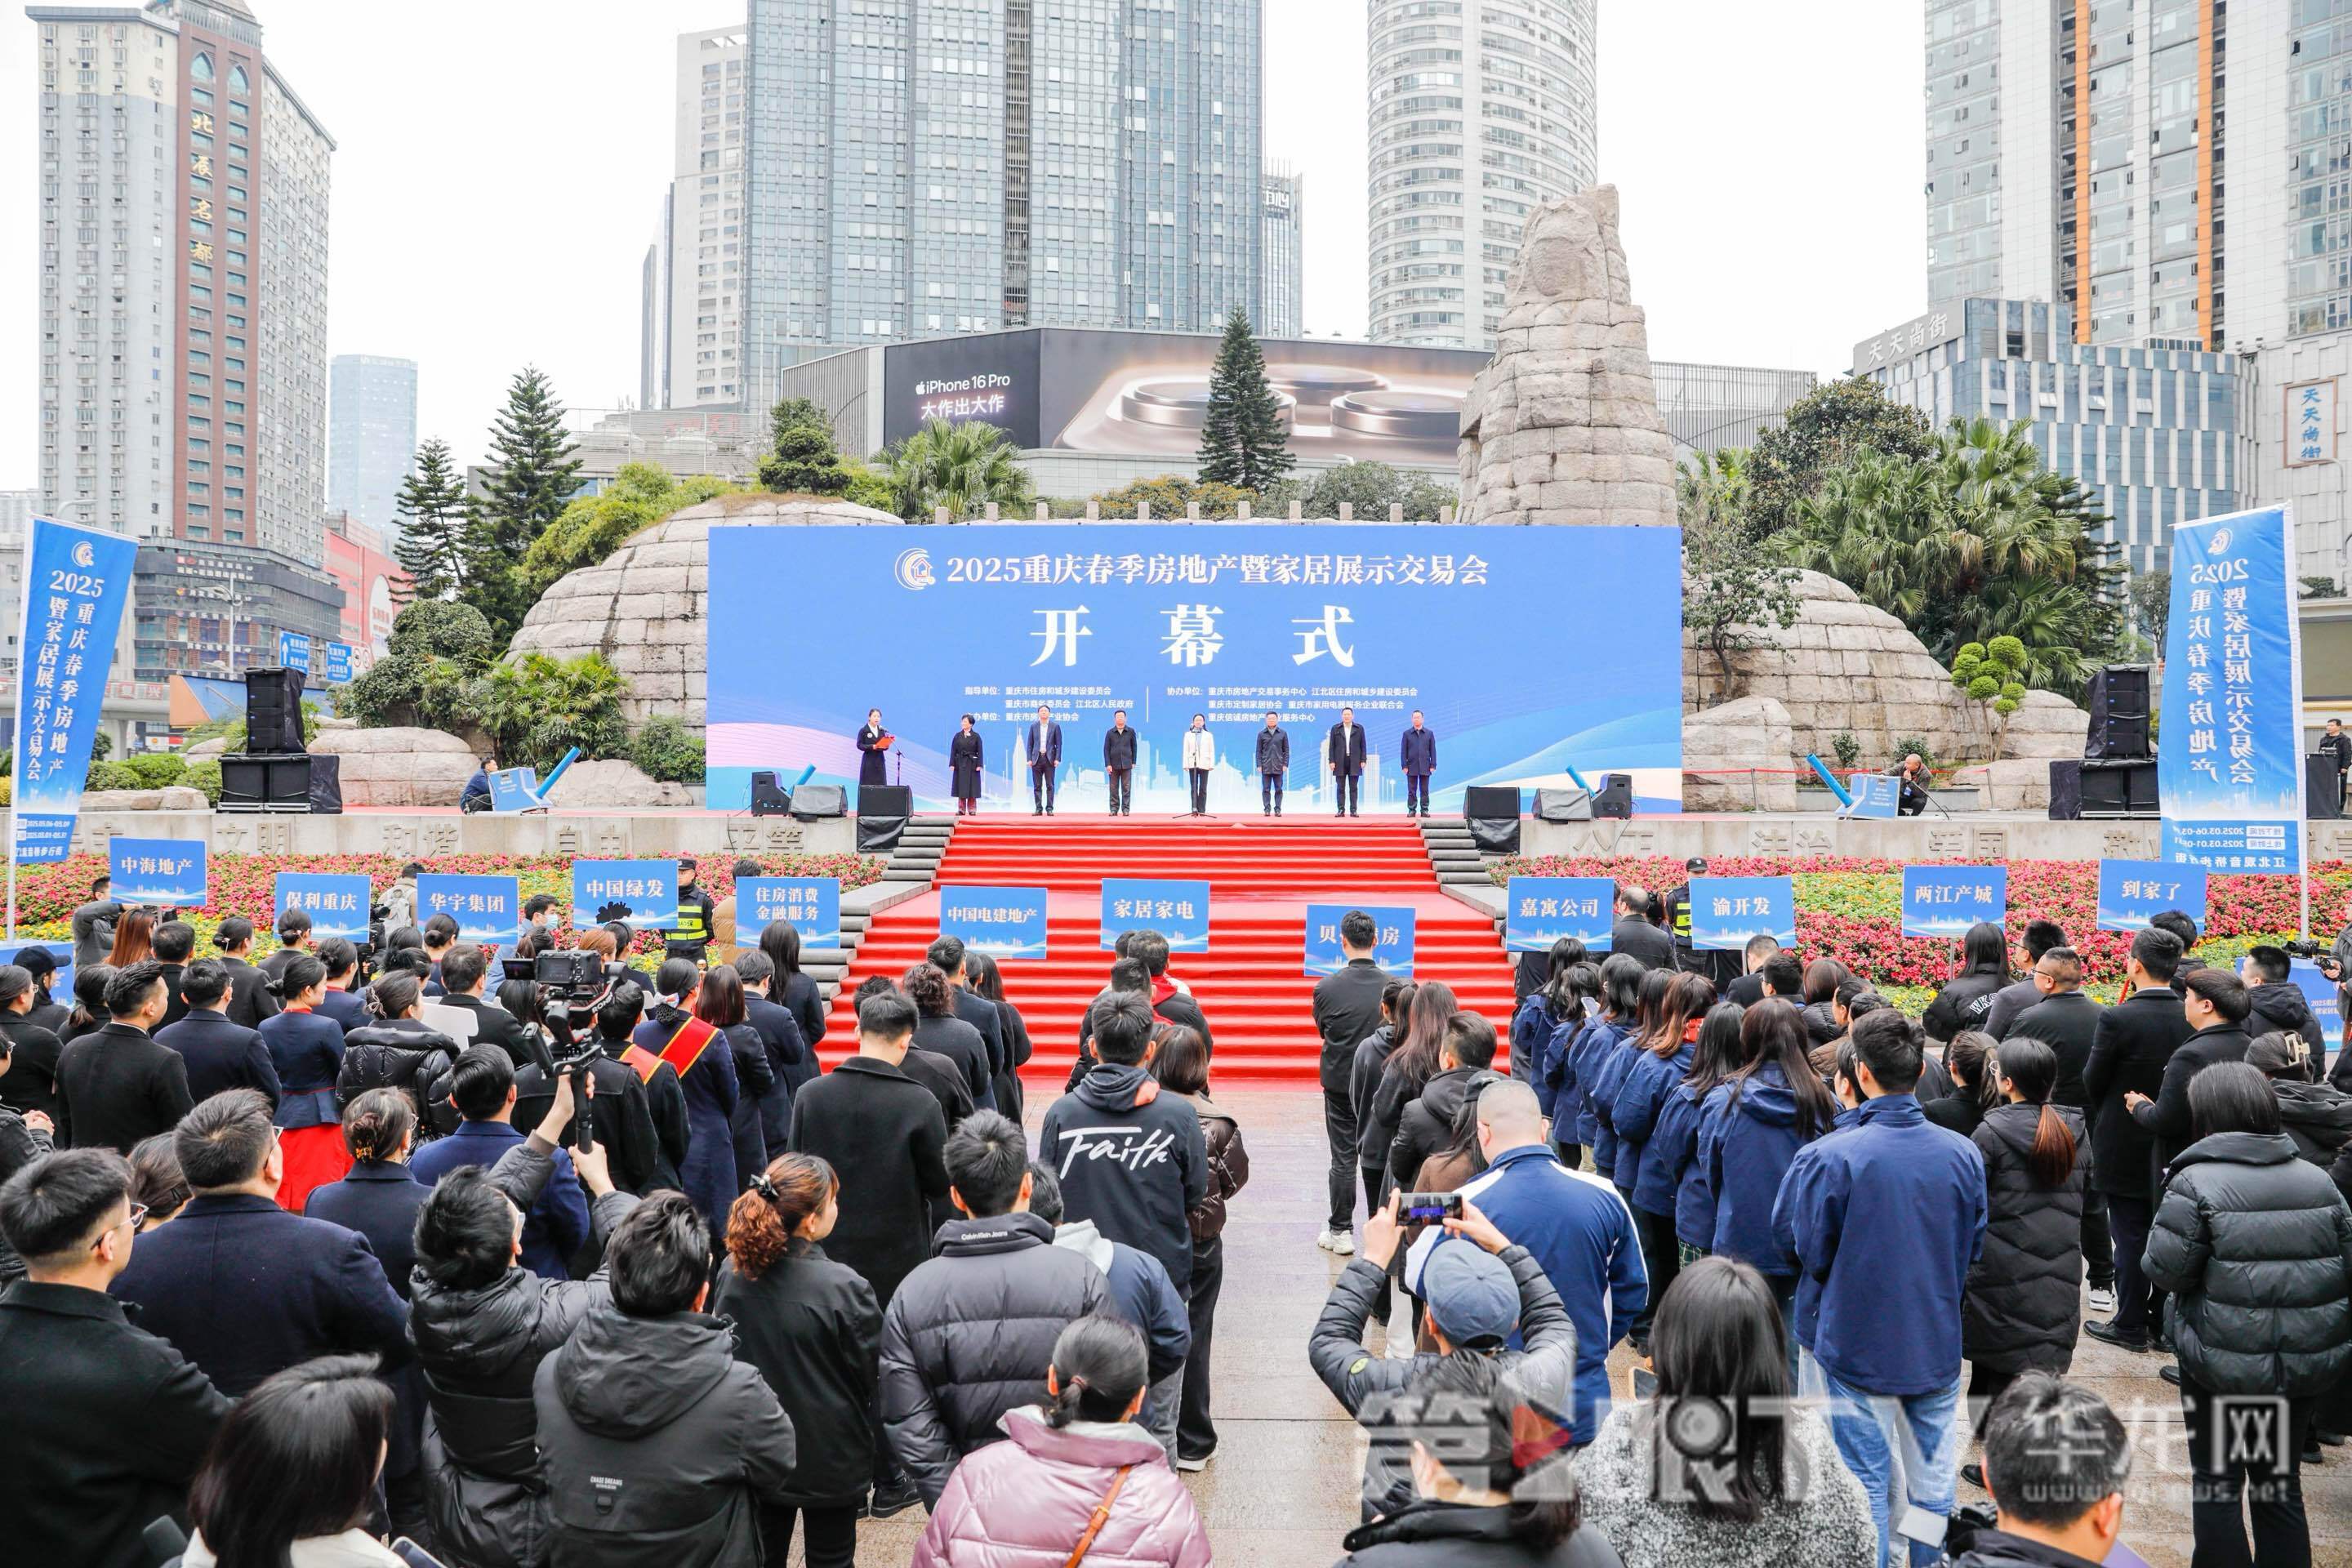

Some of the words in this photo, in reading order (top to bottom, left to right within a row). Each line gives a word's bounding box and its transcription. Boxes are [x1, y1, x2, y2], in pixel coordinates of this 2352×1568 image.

[190, 114, 214, 264] 北辰名都
[1869, 314, 1948, 367] 天天尚街
[926, 379, 969, 394] iPhone
[971, 375, 986, 389] 16
[988, 374, 1011, 388] Pro
[921, 394, 1005, 420] 大作出大作
[947, 553, 1489, 586] 2025重庆春季房地产暨家居展示交易会
[49, 570, 105, 599] 2025
[1029, 604, 1355, 667] 开幕式
[27, 595, 70, 781] 暨家居展示交易会
[47, 603, 96, 777] 重庆春季房地产
[1005, 686, 1111, 696] 重庆市住房和城乡建设委员会
[1208, 687, 1307, 696] 重庆市房地产交易事务中心
[1312, 687, 1419, 696] 江北区住房和城乡建设委员会
[1076, 699, 1134, 709] 江北区人民政府
[1208, 700, 1283, 709] 重庆市定制家居协会
[121, 857, 193, 876] 中海地产
[586, 879, 664, 898] 中国绿发
[755, 887, 819, 903] 住房消费
[1915, 884, 1993, 904] 两江产城
[2123, 880, 2182, 902] 到家了
[286, 891, 358, 912] 保利重庆
[429, 893, 504, 913] 华宇集团
[1113, 899, 1195, 920] 家居家电
[1519, 898, 1599, 918] 嘉寓公司
[1713, 897, 1771, 916] 渝开发
[756, 906, 819, 920] 金融服务
[947, 906, 1037, 924] 中国电建地产
[1058, 1126, 1174, 1179] Faith
